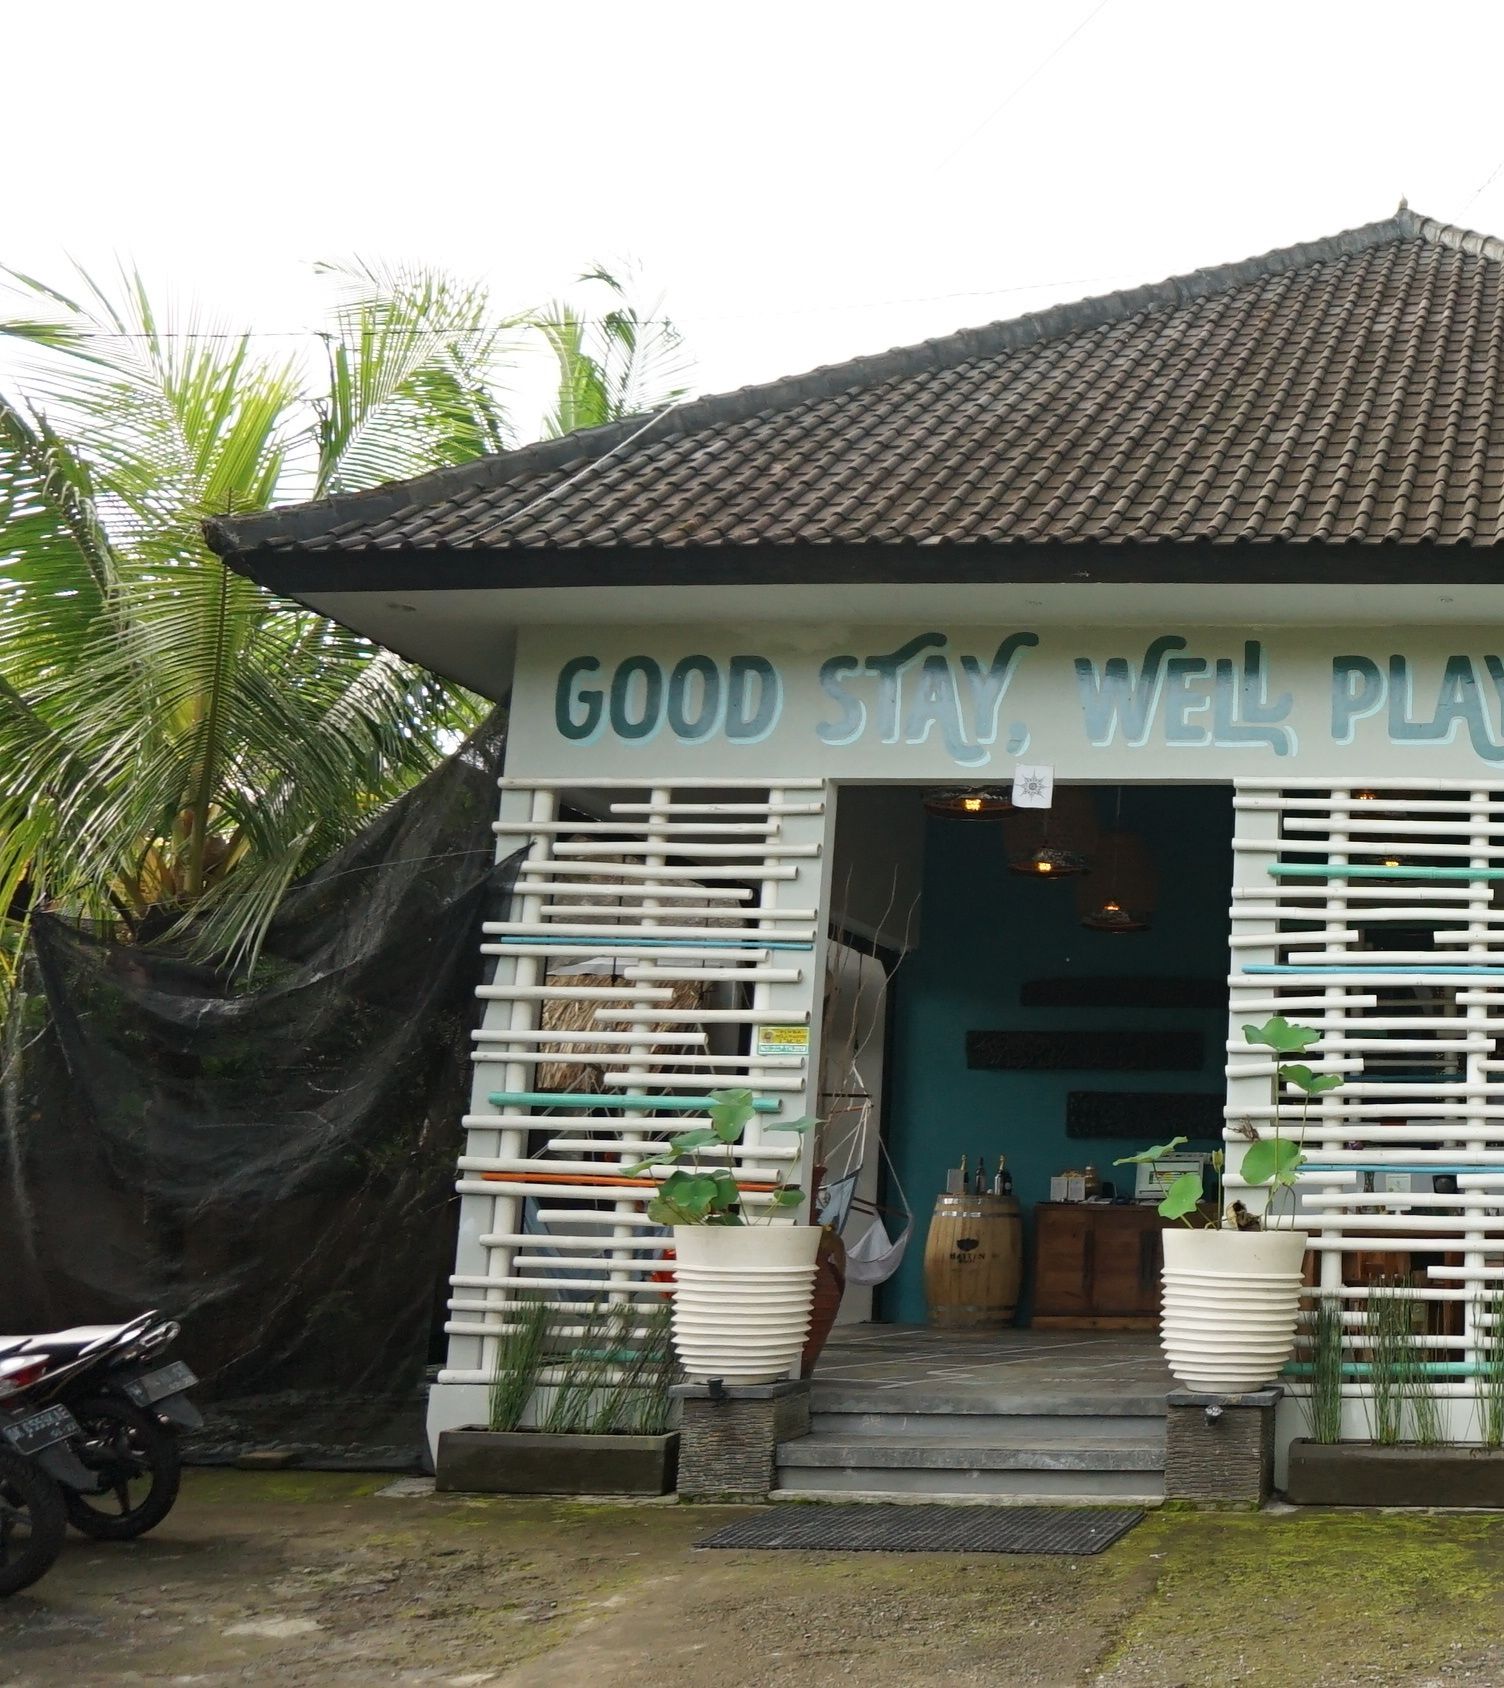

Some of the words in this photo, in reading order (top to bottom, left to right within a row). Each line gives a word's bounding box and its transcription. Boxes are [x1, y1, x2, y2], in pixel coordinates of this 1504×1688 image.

[556, 655, 783, 746] GOOD
[816, 632, 1039, 767] STAY,
[1074, 635, 1298, 757] WELL
